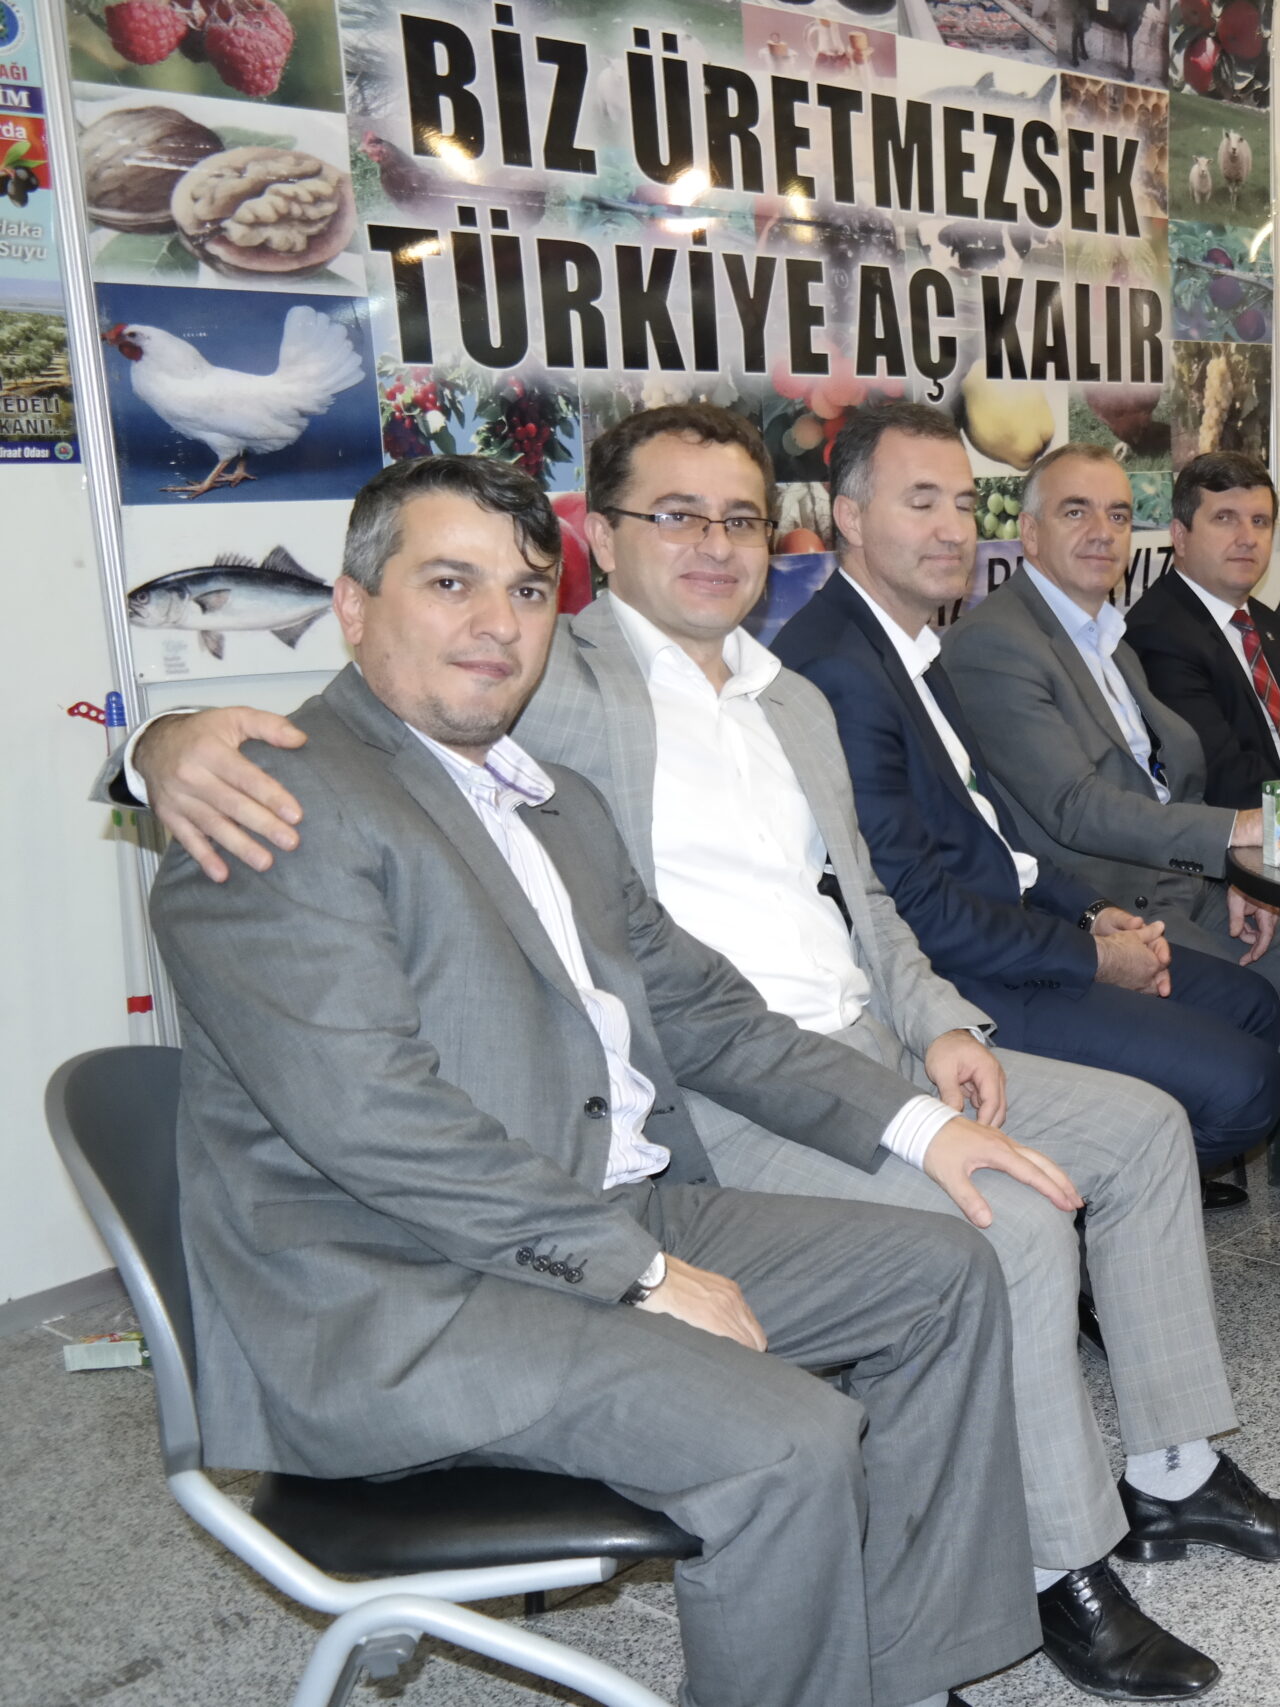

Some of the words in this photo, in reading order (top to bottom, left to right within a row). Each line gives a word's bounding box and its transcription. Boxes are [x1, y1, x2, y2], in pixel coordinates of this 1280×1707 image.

[401, 3, 597, 175] BİZ
[627, 27, 1141, 238] ÜRETMEZSEK
[367, 206, 829, 375] TÜRKİYE
[855, 263, 958, 401] AÇ
[981, 275, 1164, 384] KALIR
